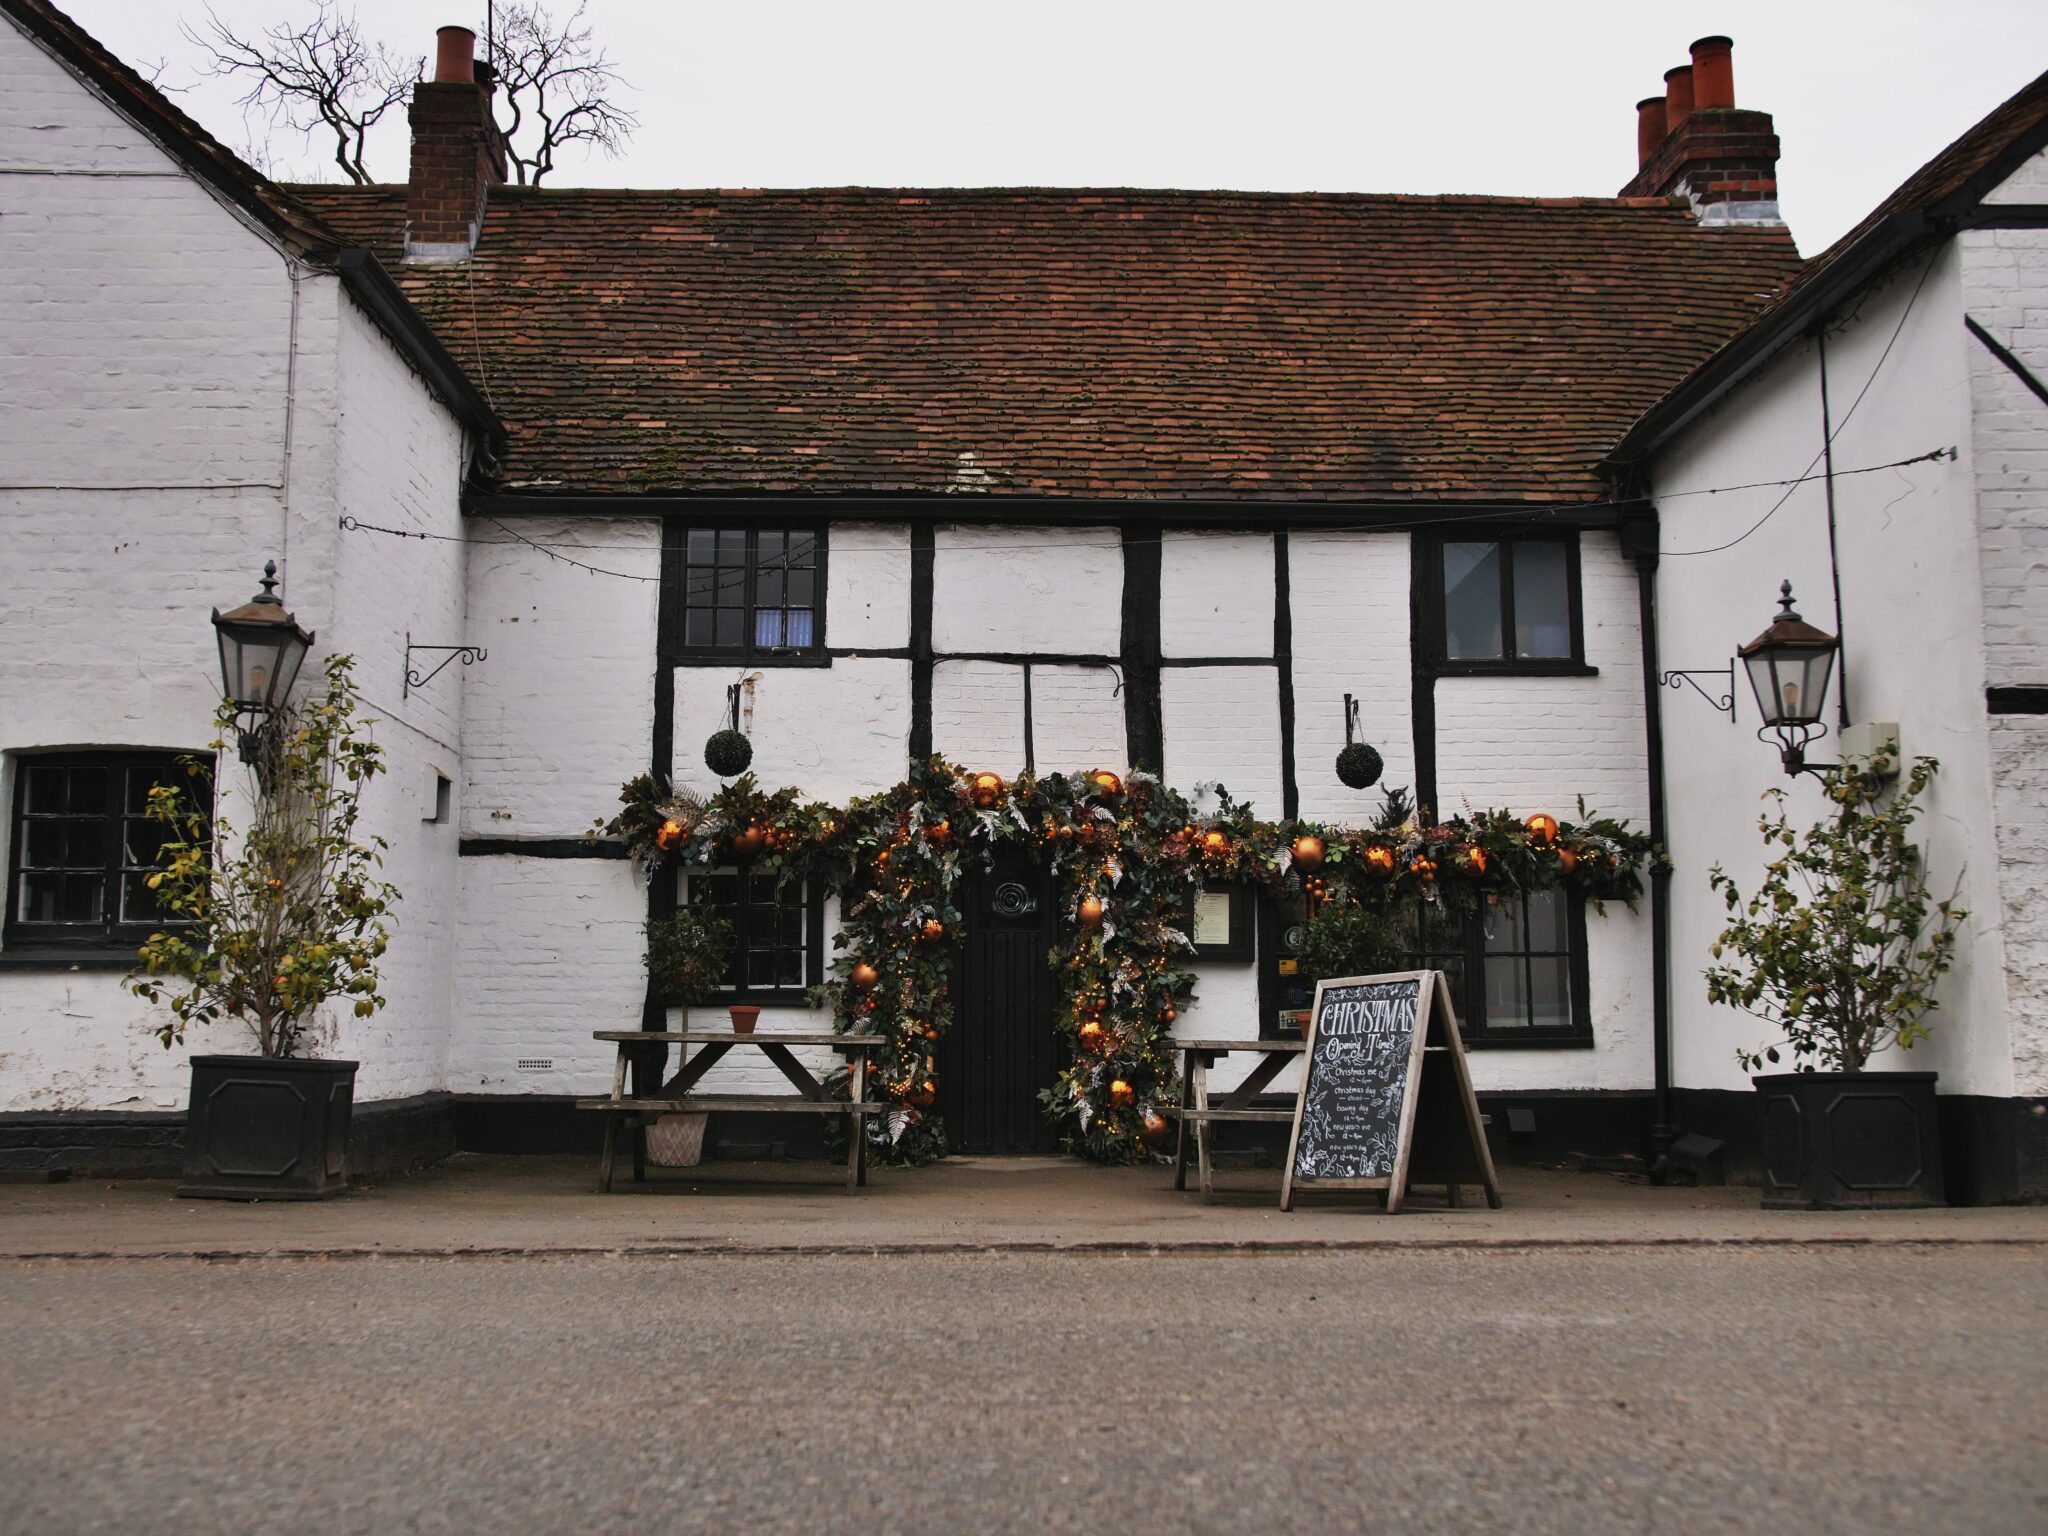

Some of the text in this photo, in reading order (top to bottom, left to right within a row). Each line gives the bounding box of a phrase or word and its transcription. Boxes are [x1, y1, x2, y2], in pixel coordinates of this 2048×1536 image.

[1320, 997, 1418, 1036] CHRISTMAS
[1326, 1033, 1395, 1061] Opening Times
[1365, 1086, 1376, 1097] day
